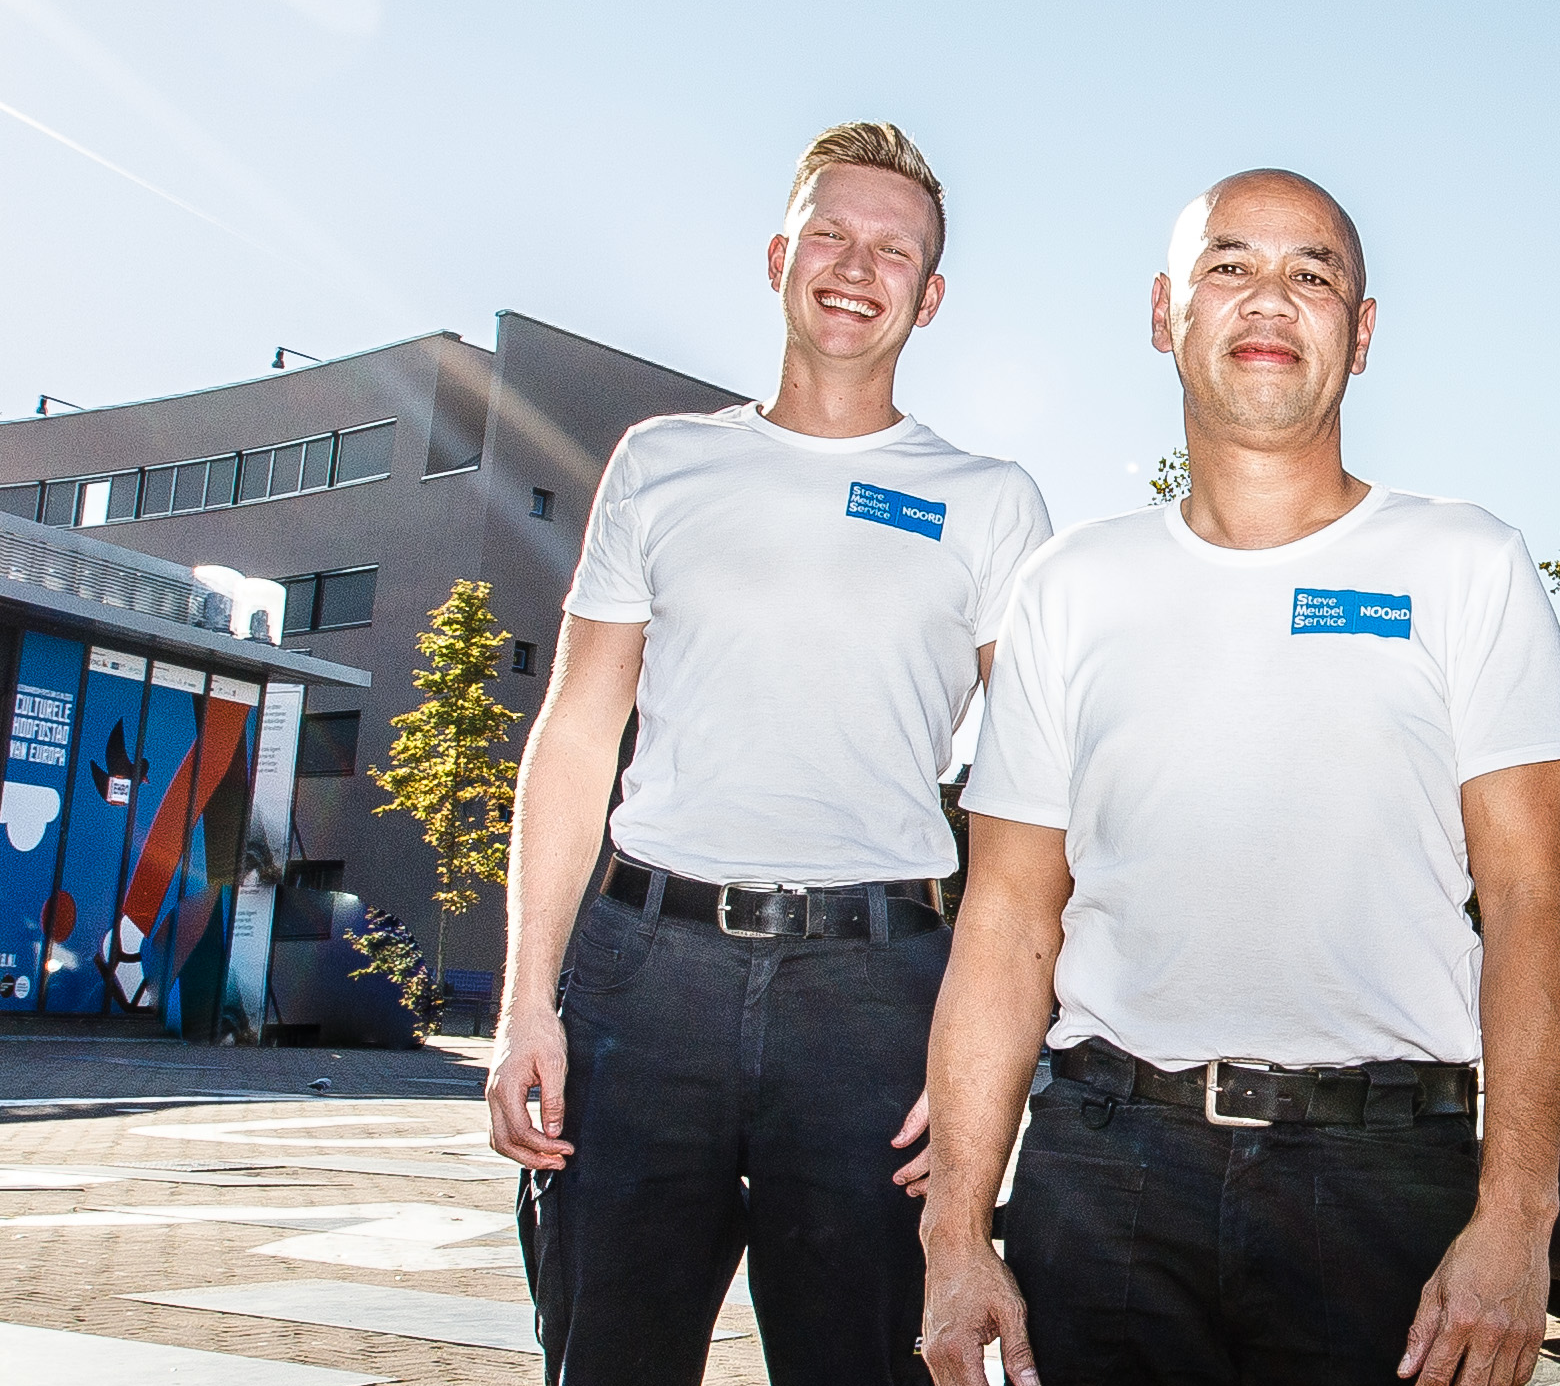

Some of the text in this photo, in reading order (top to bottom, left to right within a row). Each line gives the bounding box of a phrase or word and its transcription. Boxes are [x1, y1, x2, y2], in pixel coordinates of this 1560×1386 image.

[852, 486, 884, 500] Steve
[850, 494, 890, 511] Meubel
[848, 502, 891, 520] Service
[902, 506, 943, 525] NOORD
[1296, 594, 1337, 606] Steve
[1295, 605, 1343, 616] Meubel
[1360, 606, 1410, 620] NOORD
[1294, 616, 1346, 628] Service
[15, 694, 72, 723] CULTURELE
